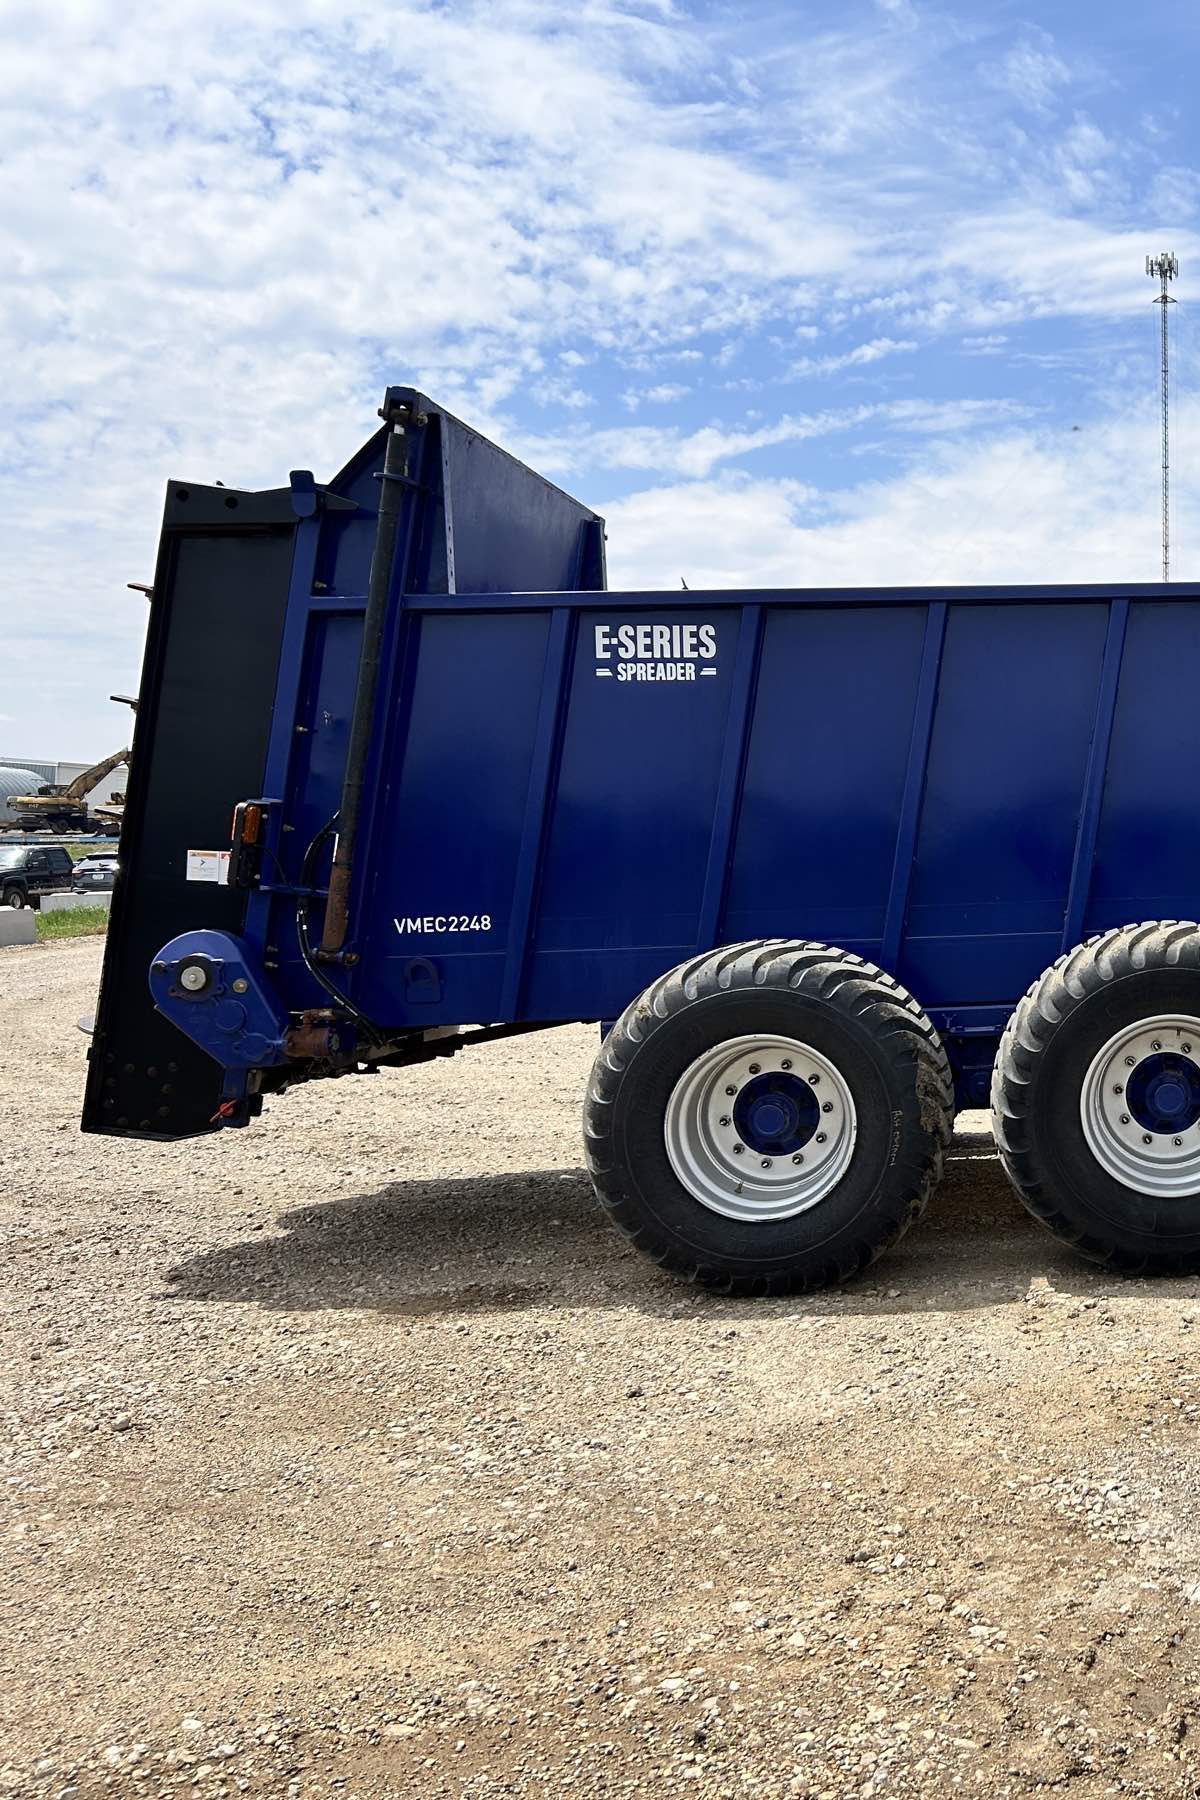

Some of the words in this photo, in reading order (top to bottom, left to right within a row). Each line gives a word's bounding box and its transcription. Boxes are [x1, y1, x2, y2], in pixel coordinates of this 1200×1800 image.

[595, 625, 717, 659] E-SERIES
[617, 662, 696, 681] SPREADER
[393, 915, 491, 934] VMEC2248
